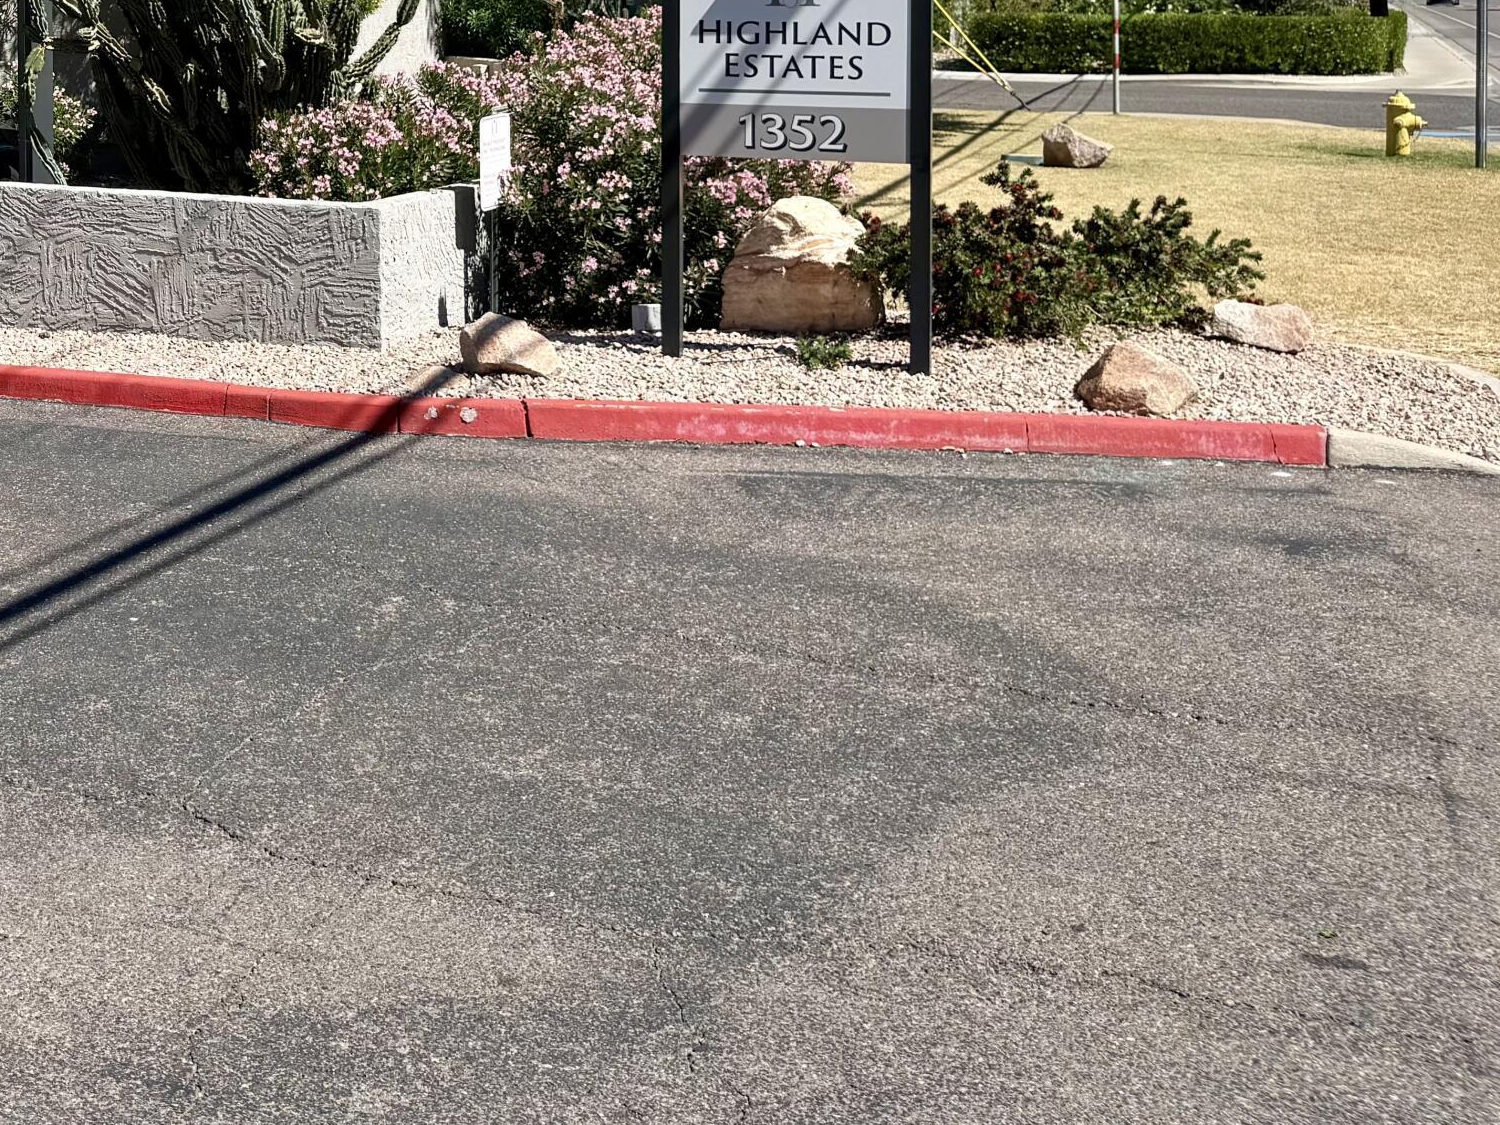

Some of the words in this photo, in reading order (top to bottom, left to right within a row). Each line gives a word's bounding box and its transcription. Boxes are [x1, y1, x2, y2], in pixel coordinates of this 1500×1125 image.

[698, 19, 892, 46] HIGHLAND
[724, 52, 863, 80] ESTATES
[738, 113, 848, 153] 1352
